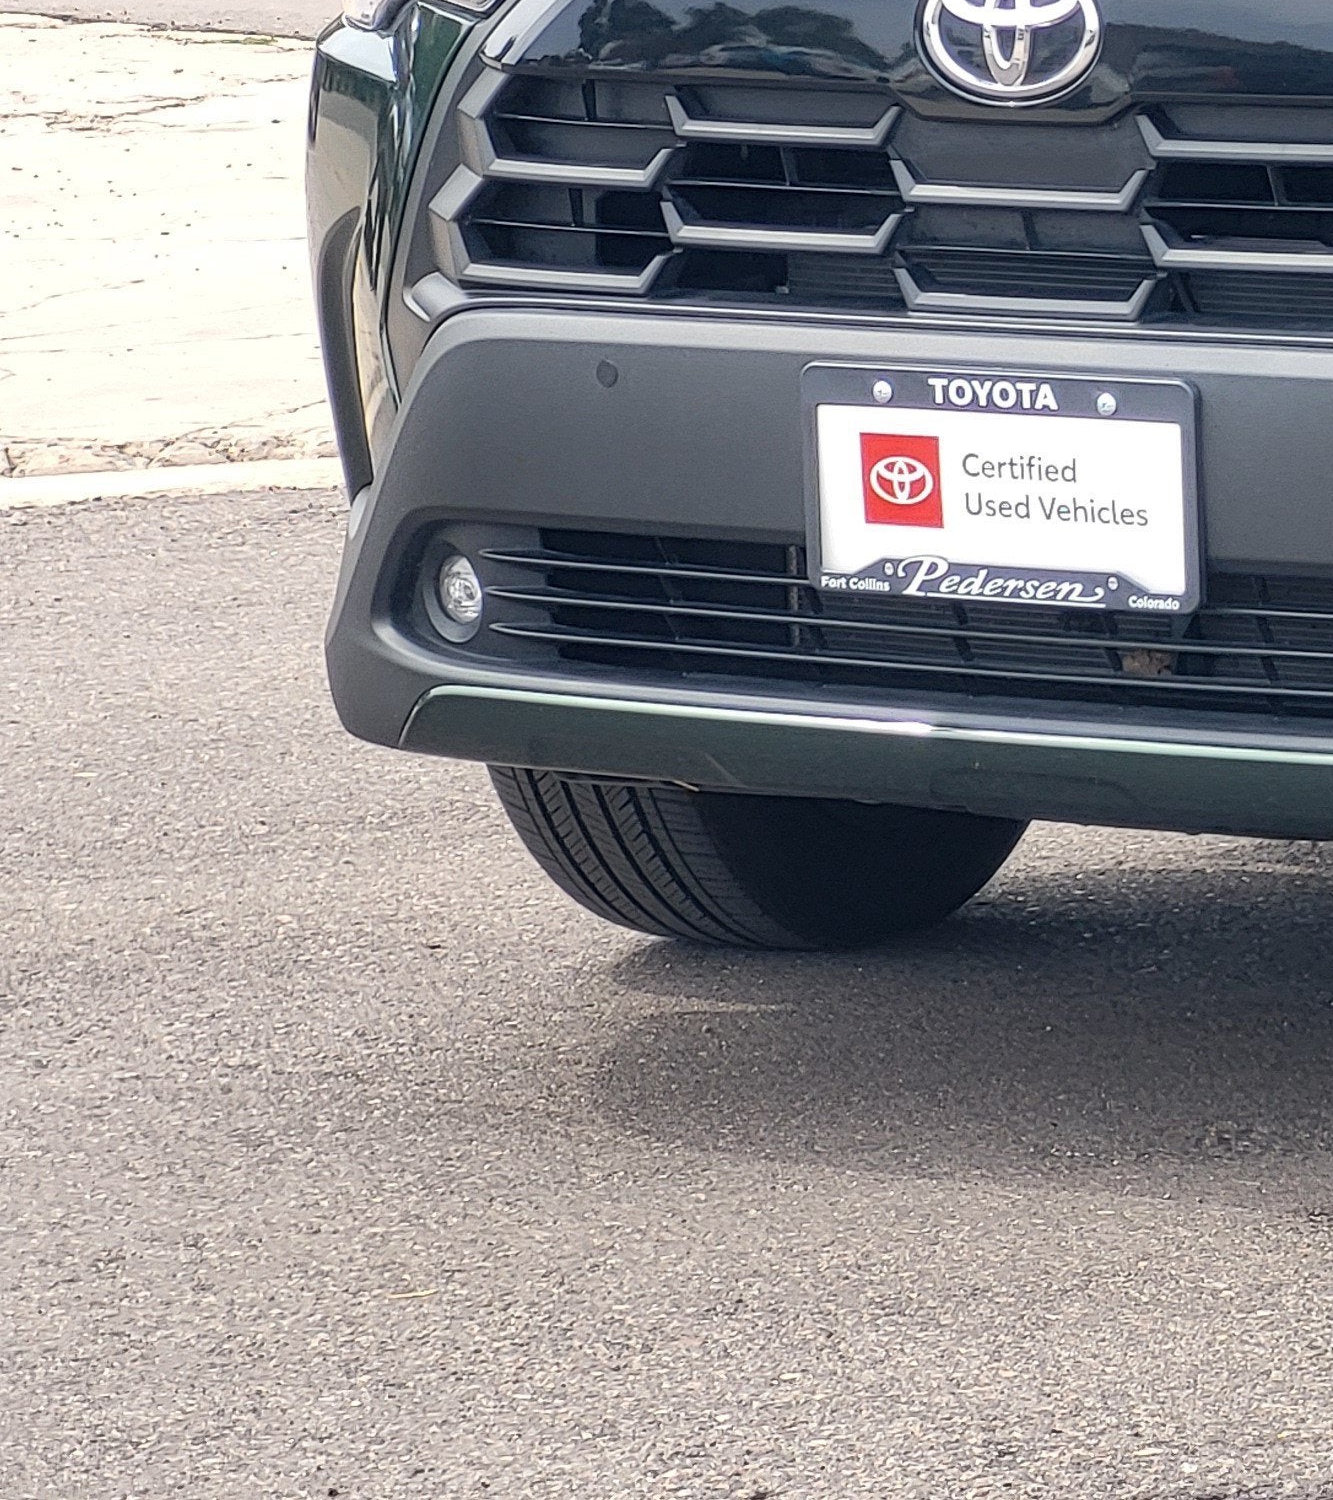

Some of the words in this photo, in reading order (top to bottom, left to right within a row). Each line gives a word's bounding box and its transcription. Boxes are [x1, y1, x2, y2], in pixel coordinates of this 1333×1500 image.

[927, 377, 1059, 412] TOYOTA
[961, 453, 1078, 484] Certified
[965, 492, 1032, 520] Used
[1038, 495, 1150, 528] Vehicles
[820, 575, 848, 590] Fort
[848, 576, 892, 593] Collins
[896, 555, 1106, 603] Pedersen
[1128, 595, 1180, 612] Colorado
